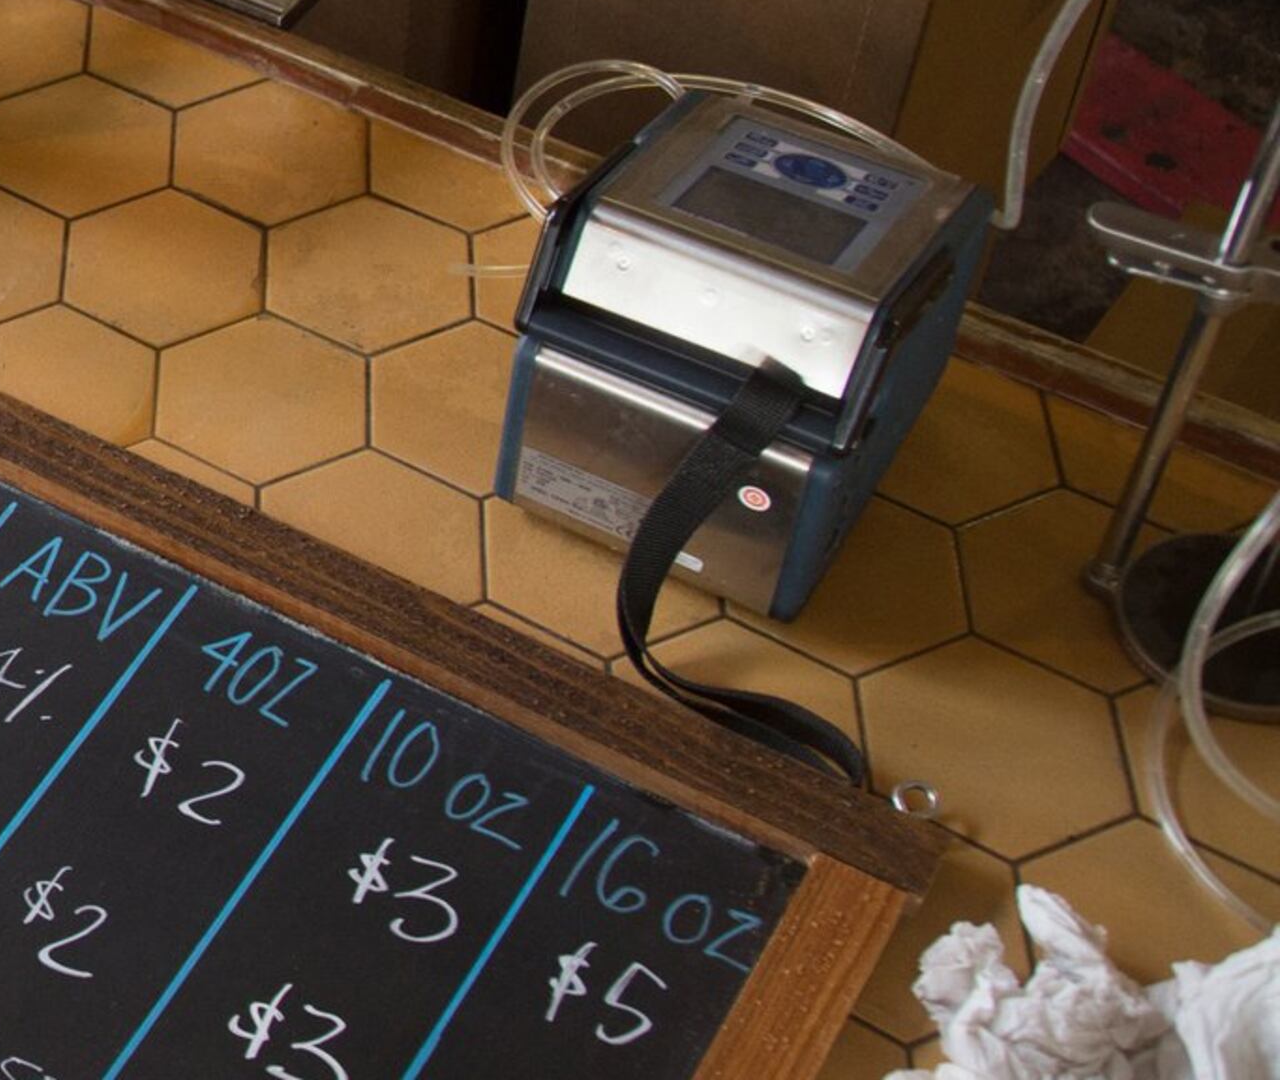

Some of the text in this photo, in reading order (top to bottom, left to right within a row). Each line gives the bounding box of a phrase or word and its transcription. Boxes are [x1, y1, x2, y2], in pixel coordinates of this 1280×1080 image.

[133, 718, 246, 826] $2
[360, 708, 440, 789] 10
[346, 837, 460, 943] $3
[559, 818, 661, 914] 16
[22, 865, 109, 979] $2
[227, 982, 348, 1080] $3
[544, 940, 669, 1046] $5
